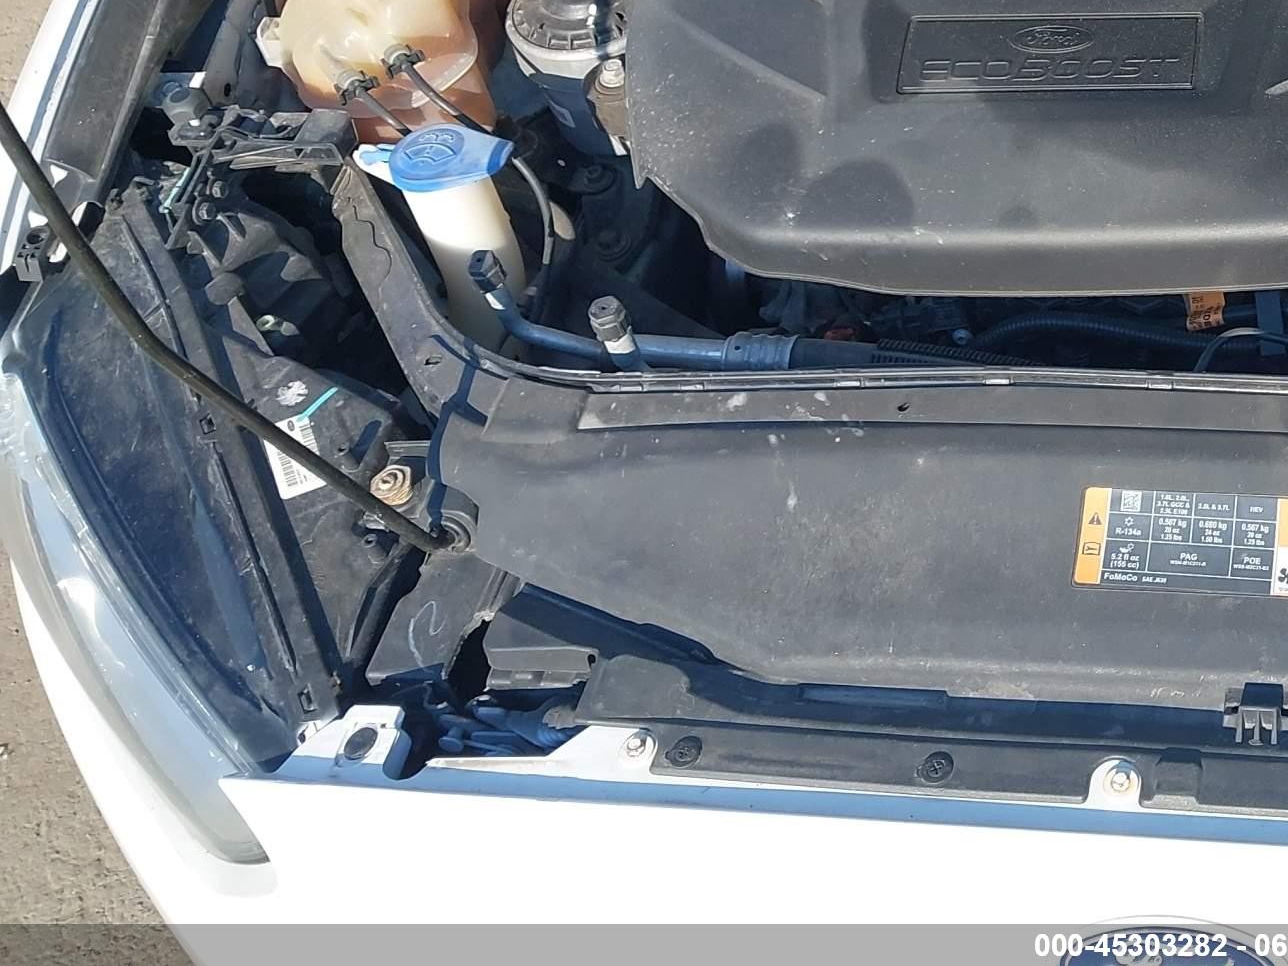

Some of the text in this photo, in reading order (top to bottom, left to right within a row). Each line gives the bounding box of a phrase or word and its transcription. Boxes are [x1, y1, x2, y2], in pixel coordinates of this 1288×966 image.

[920, 58, 1180, 83] ECOBOOST
[1178, 519, 1187, 528] kg
[1218, 521, 1227, 531] kg
[1115, 527, 1142, 536] R-134a
[1260, 524, 1269, 534] kg
[1123, 553, 1129, 561] fl
[1180, 552, 1198, 561] PAG
[1243, 556, 1261, 565] POE
[1127, 562, 1139, 570] cc)
[1104, 572, 1138, 582] FoMoCo
